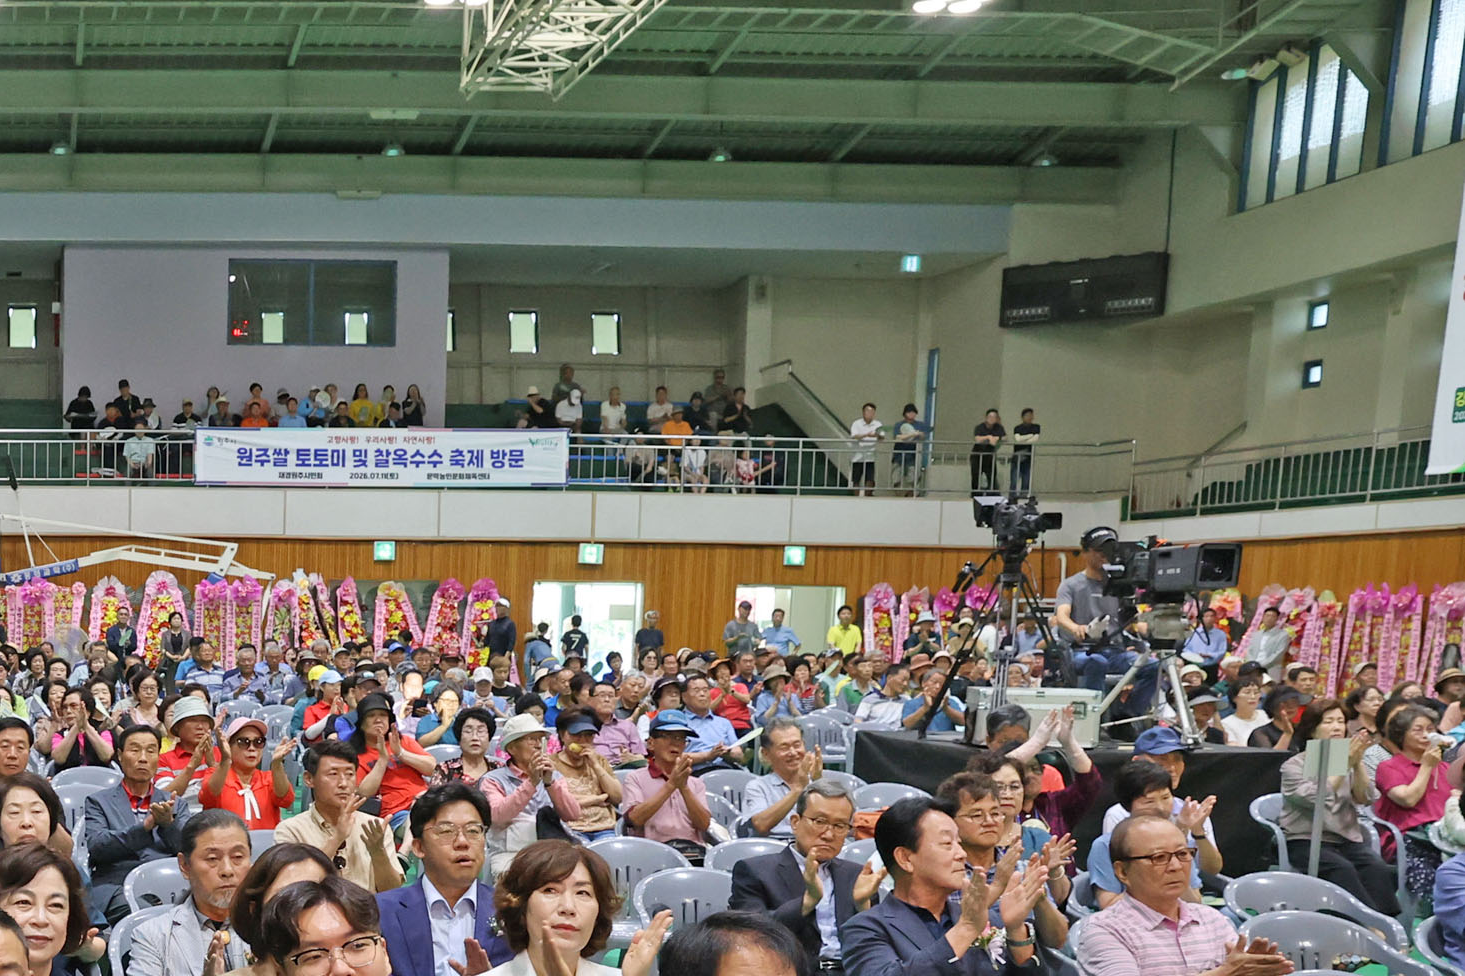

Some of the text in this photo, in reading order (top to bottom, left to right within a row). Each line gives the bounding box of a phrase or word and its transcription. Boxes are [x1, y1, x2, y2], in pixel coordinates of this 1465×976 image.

[327, 436, 436, 445] 고향사랑! 우리사랑! 자연사랑!
[236, 447, 524, 469] 원주쌀 토토미 및 찰옥수수 축제 방문
